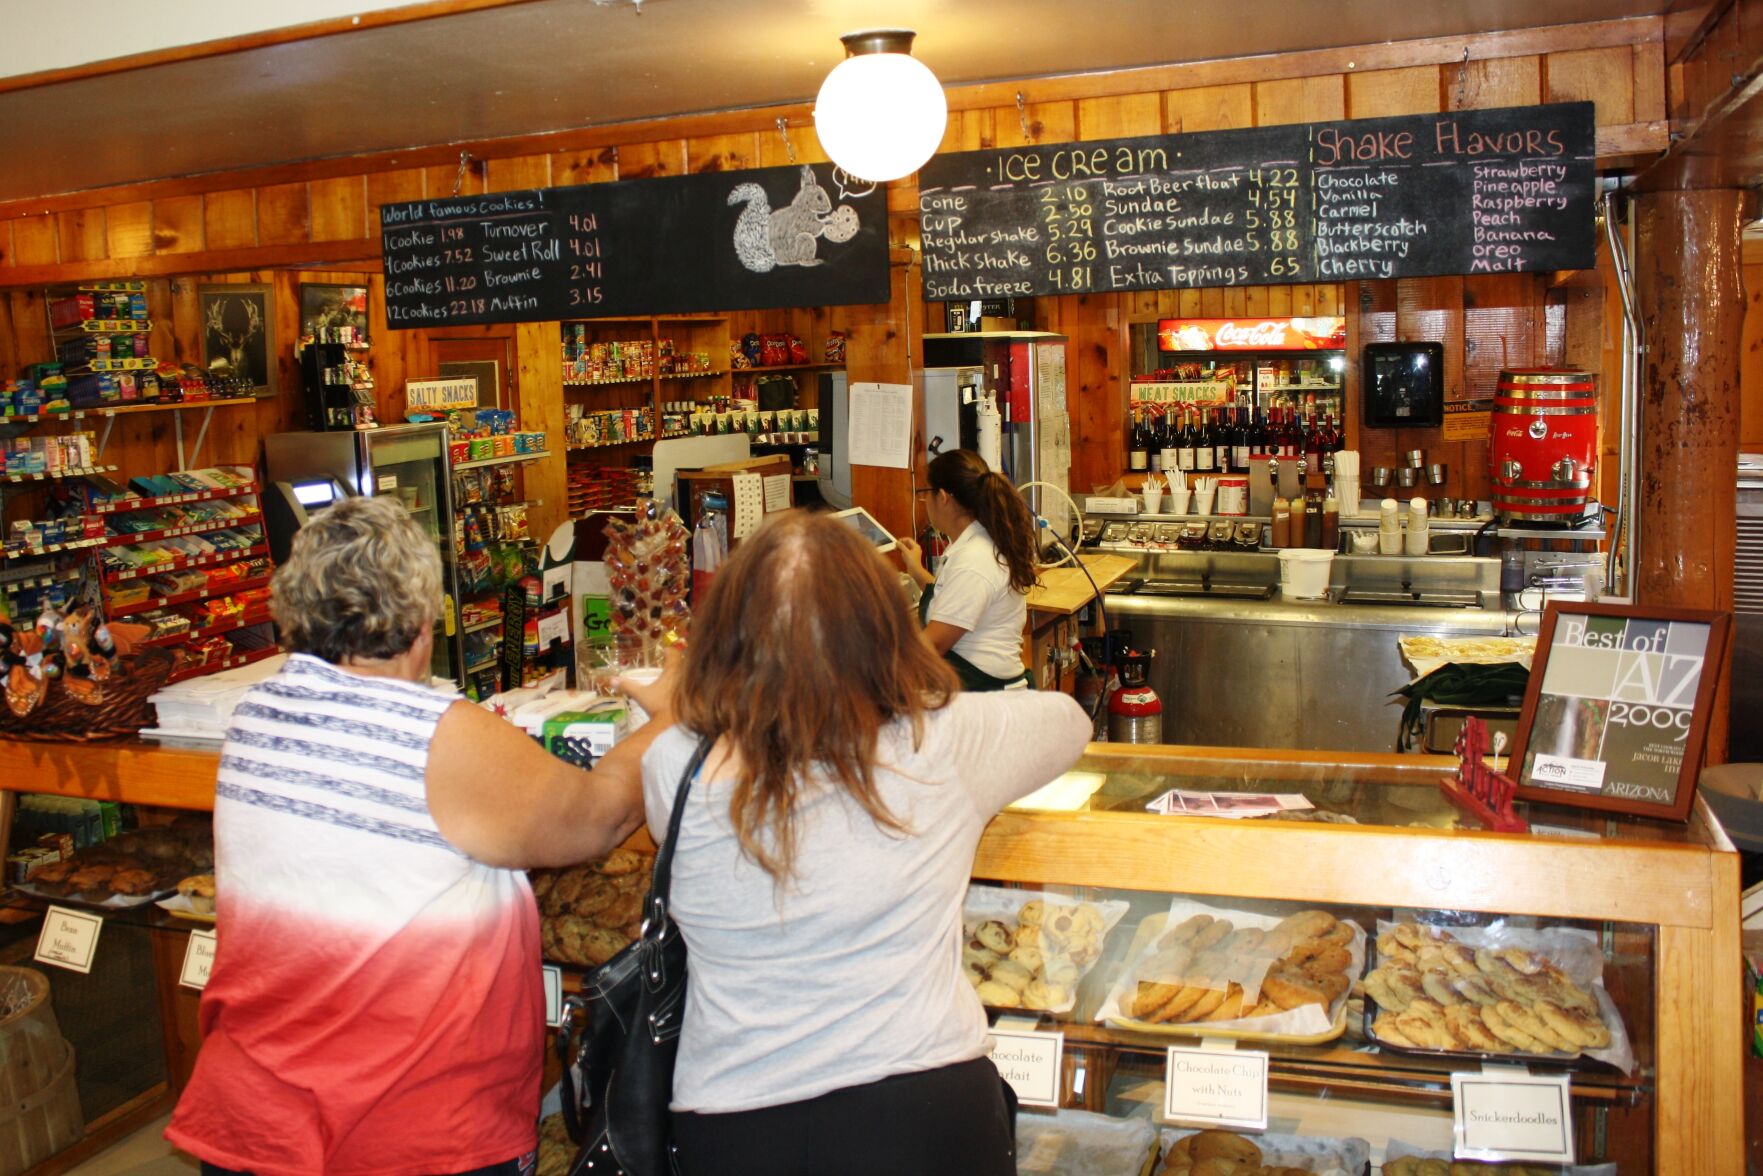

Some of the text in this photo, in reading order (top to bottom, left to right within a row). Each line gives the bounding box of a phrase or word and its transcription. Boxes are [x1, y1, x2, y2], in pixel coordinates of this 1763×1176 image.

[1317, 171, 1399, 189] Chocolate
[1473, 162, 1567, 182] Strawberry
[1103, 181, 1146, 197] Root
[1149, 177, 1194, 196] Beer
[1248, 169, 1300, 188] 4.22
[1473, 178, 1556, 196] Pineapple
[920, 186, 1087, 214] Cone 2.10
[1104, 190, 1297, 216] Sundae 4.54
[1319, 189, 1383, 202] Vanilla
[1472, 194, 1568, 212] Raspberry
[383, 203, 423, 224] World
[921, 203, 1093, 235] Cup 2.50
[1319, 202, 1377, 219] Carmel
[1472, 210, 1521, 226] Peach
[480, 213, 598, 239] Turnover 4.01
[1104, 210, 1297, 237] Cookie Sundae 5.88
[1317, 218, 1427, 237] Butterscotch
[440, 227, 465, 244] 1.98
[921, 231, 989, 255] Regular
[1047, 219, 1093, 242] 5.29
[1474, 226, 1556, 242] Banana
[482, 239, 601, 263] Sweet Roll 4.01
[1105, 231, 1300, 260] Brownie Sundae 5.88
[1316, 237, 1409, 257] Blackberry
[444, 248, 474, 265] 7.52
[924, 250, 971, 273] Thick
[1046, 241, 1098, 264] 6.36
[1470, 258, 1528, 274] Malt
[484, 262, 603, 287] Brownie 2.41
[1109, 265, 1162, 288] Extra
[1167, 263, 1249, 288] Toppings
[1320, 258, 1394, 278] Cherry
[445, 276, 477, 293] 11.20
[1048, 266, 1092, 291] 4.81
[450, 299, 486, 315] 22.18
[489, 287, 604, 312] Muffin 3.15
[1215, 321, 1291, 347] Coca-Cola
[410, 384, 474, 406] SALTY SNACKS
[1138, 385, 1217, 401] MEAT SNACKS
[1443, 403, 1473, 413] NOTICE
[1564, 620, 1667, 654] Best of
[1606, 652, 1704, 709] AZ
[1609, 703, 1693, 742] 2009
[1604, 781, 1670, 801] ARIZONA
[991, 1048, 1043, 1063] hocolate
[1000, 1067, 1031, 1081] arfait
[1176, 1060, 1261, 1079] Chocolate Chip
[1192, 1083, 1243, 1097] with Nuts
[1470, 1110, 1558, 1126] Snickerdoodles
